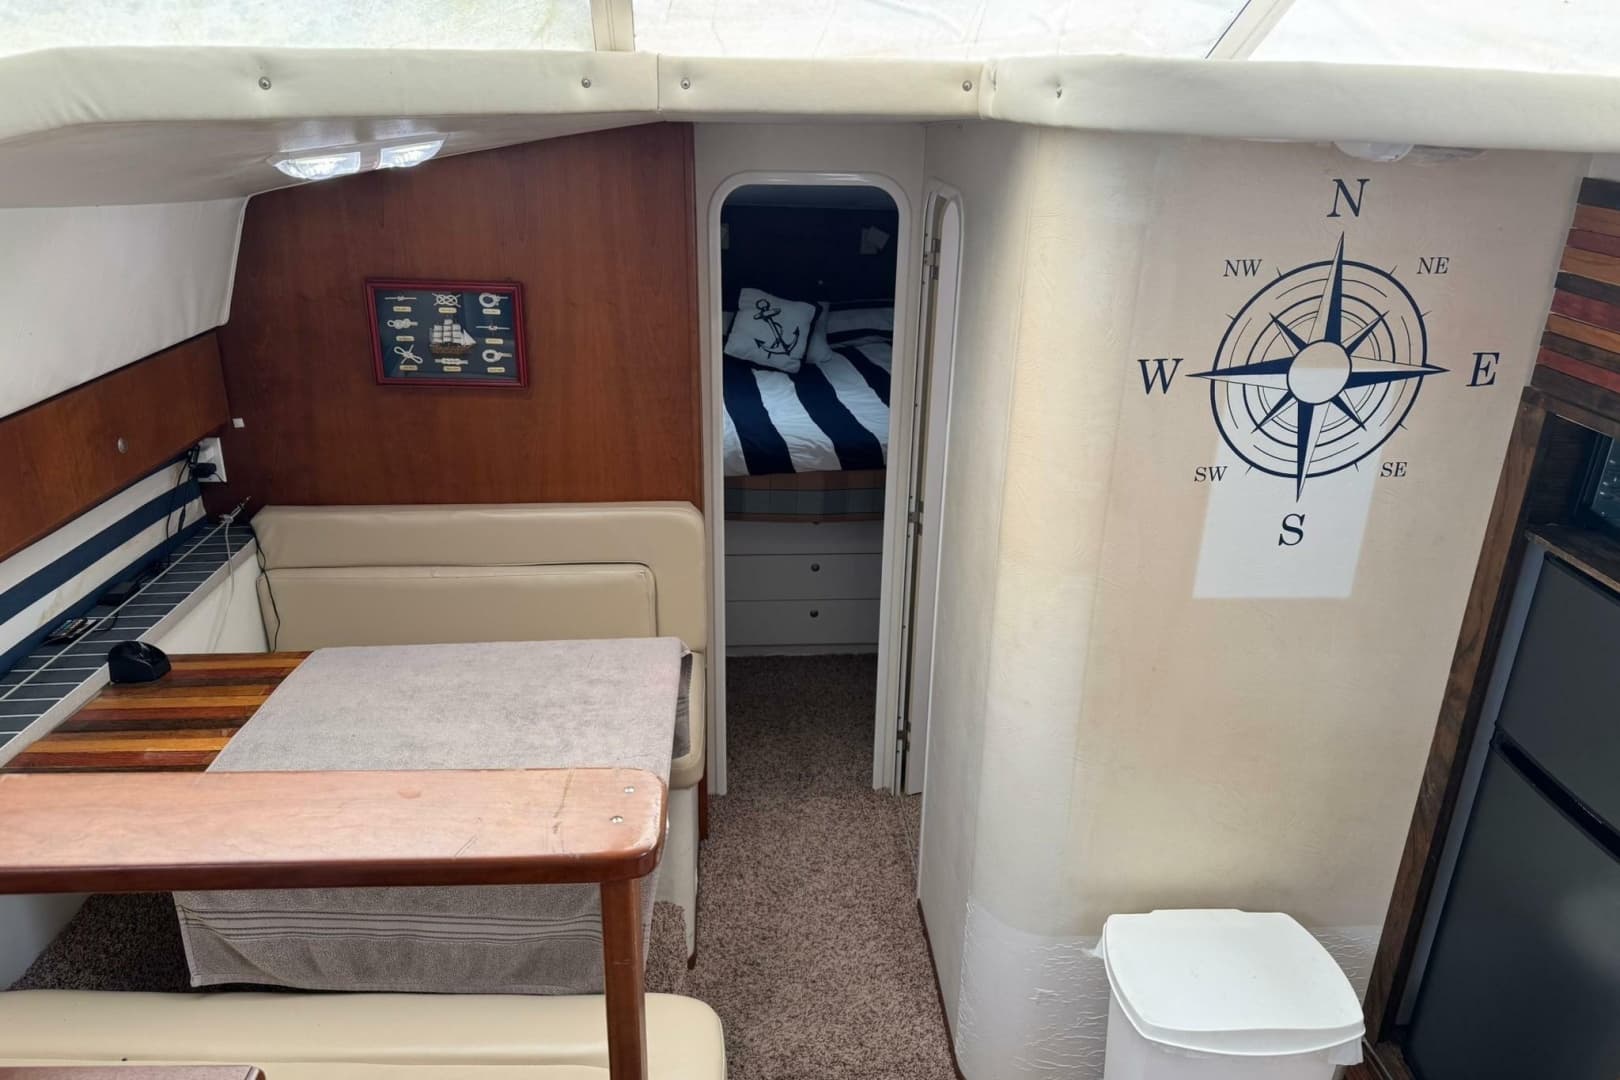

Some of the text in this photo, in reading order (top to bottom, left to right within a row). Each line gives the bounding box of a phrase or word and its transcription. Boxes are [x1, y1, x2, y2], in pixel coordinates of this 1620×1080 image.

[1327, 179, 1370, 217] N
[1223, 259, 1263, 277] NW
[1417, 257, 1450, 275] NE
[1137, 358, 1184, 395] W
[1466, 352, 1500, 387] E
[1194, 466, 1228, 482] SW
[1380, 461, 1408, 478] SE
[1278, 513, 1306, 546] S
